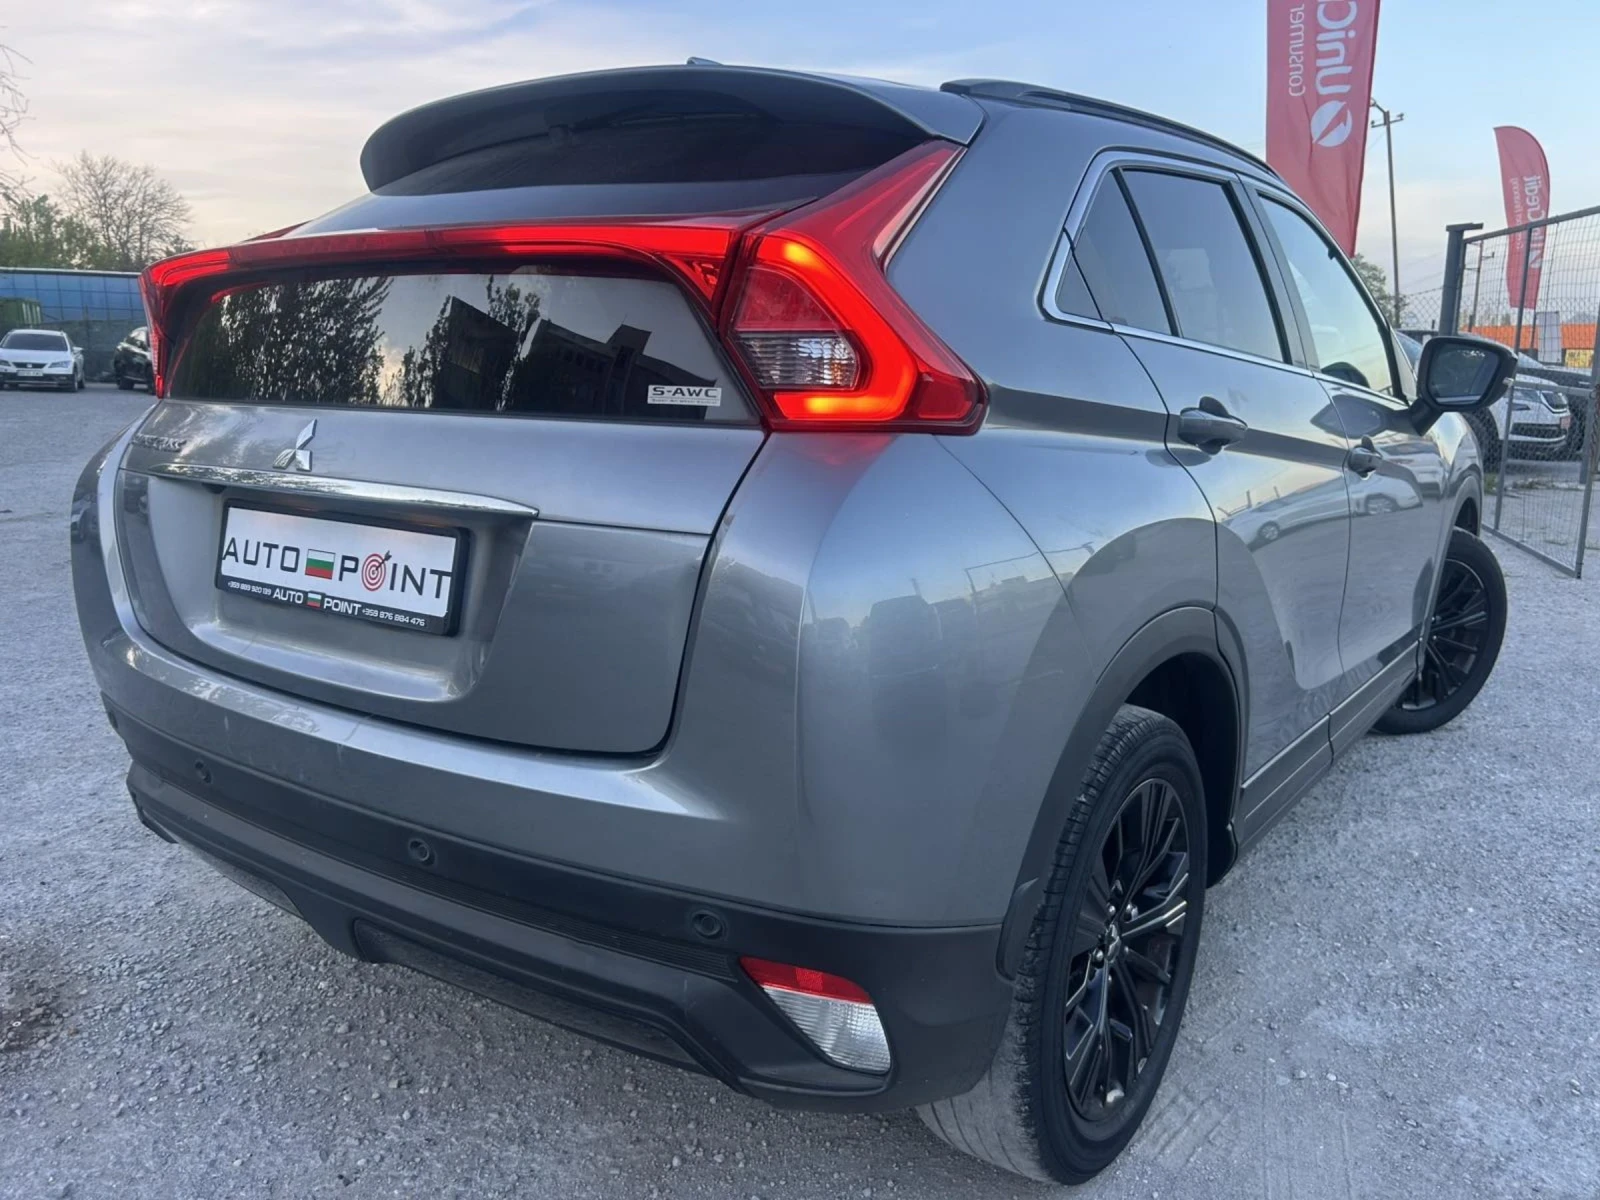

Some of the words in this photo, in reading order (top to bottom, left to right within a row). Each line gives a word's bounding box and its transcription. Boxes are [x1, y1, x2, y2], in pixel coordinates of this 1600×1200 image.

[652, 387, 717, 398] S-AWC
[222, 537, 300, 573] AUTO
[272, 588, 304, 604] AUTO
[323, 597, 362, 616] POINT
[379, 611, 394, 620] 876
[410, 617, 425, 627] 476
